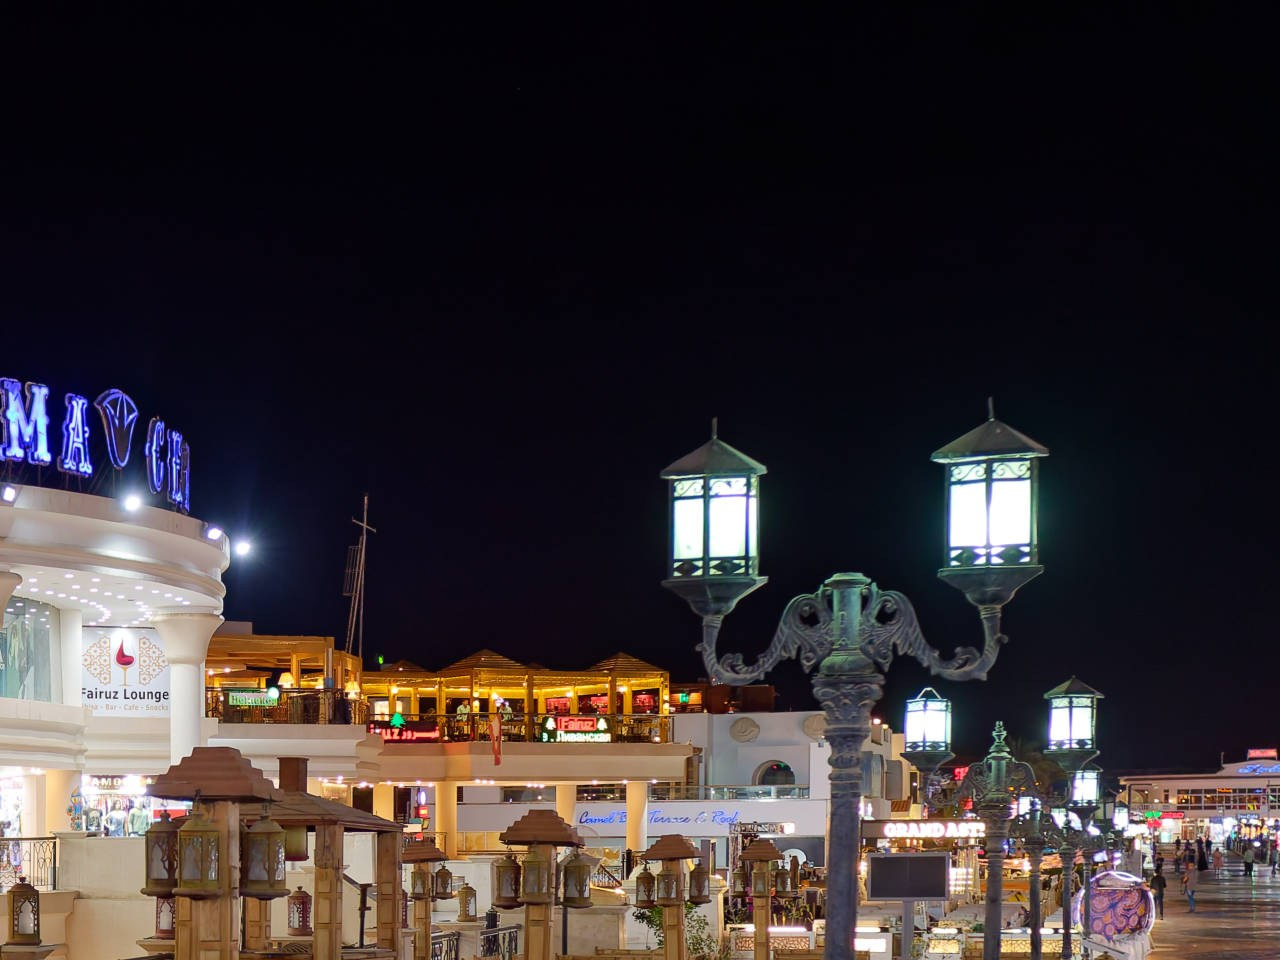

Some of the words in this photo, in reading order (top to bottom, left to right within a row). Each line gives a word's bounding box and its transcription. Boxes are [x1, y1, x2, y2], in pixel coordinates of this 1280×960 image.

[81, 688, 119, 700] Fairuz
[123, 688, 169, 702] Lounge
[883, 822, 945, 838] GRAND
